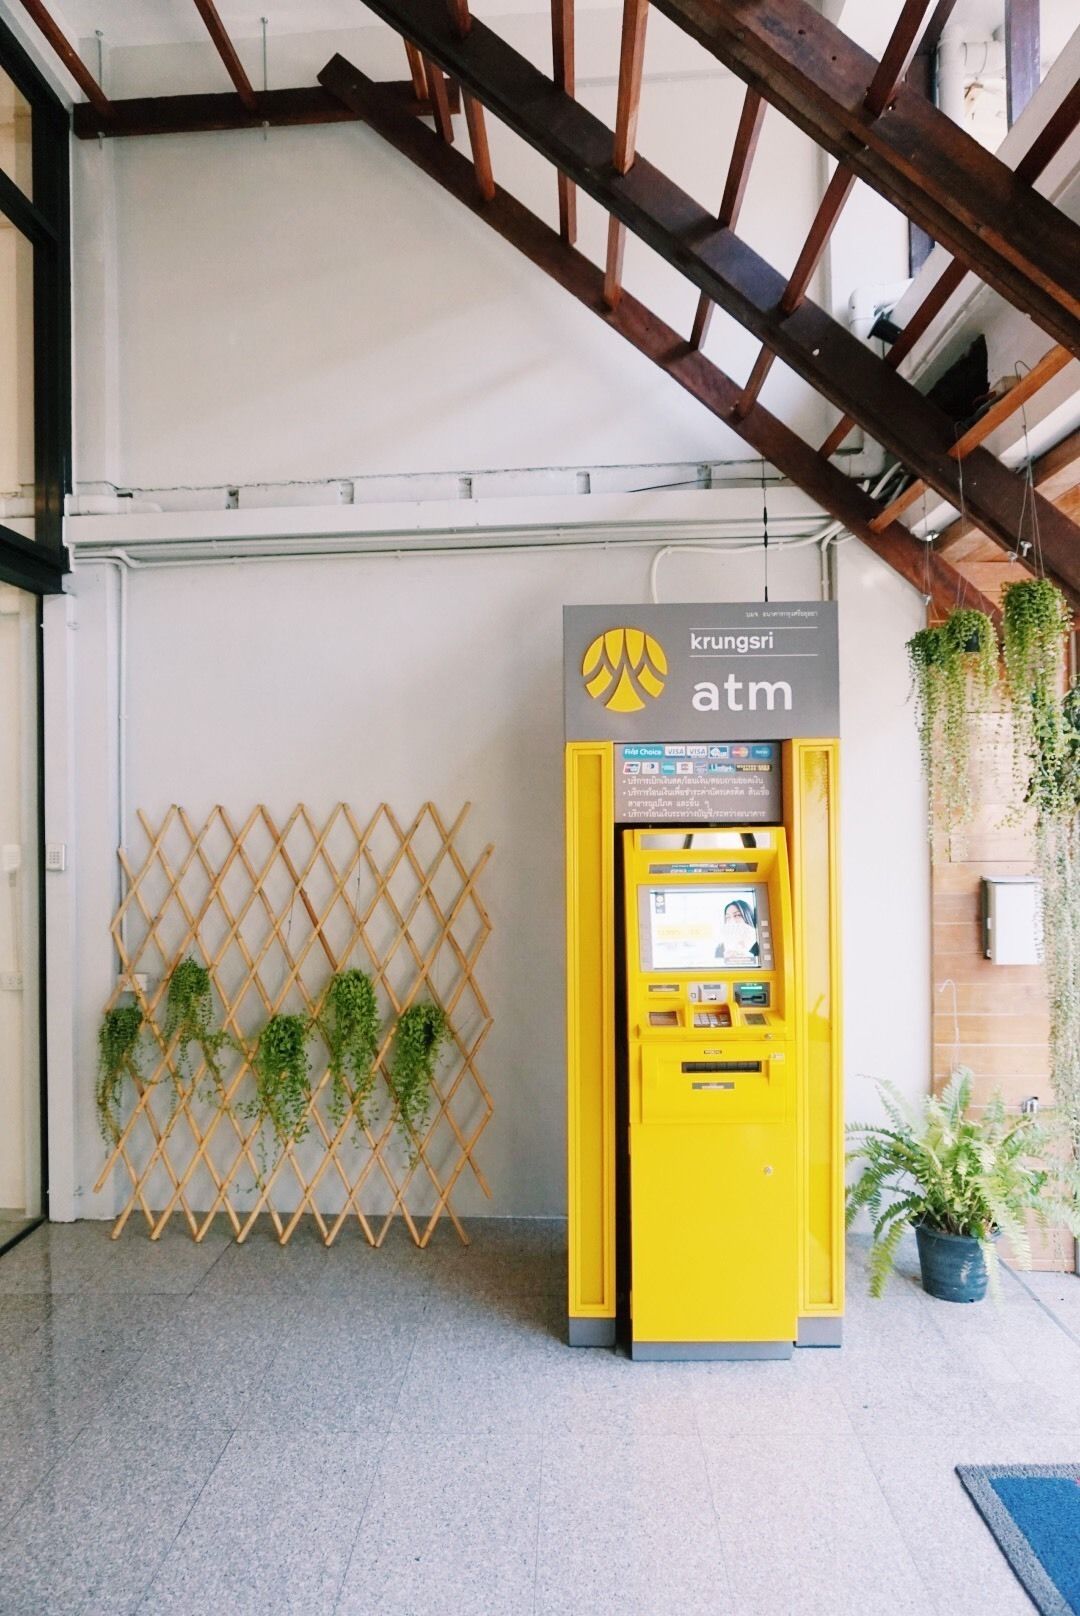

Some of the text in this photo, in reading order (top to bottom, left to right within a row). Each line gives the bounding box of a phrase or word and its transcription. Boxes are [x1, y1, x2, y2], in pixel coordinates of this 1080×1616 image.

[690, 631, 774, 653] krungsri
[692, 673, 793, 712] atm
[639, 748, 662, 756] Choice
